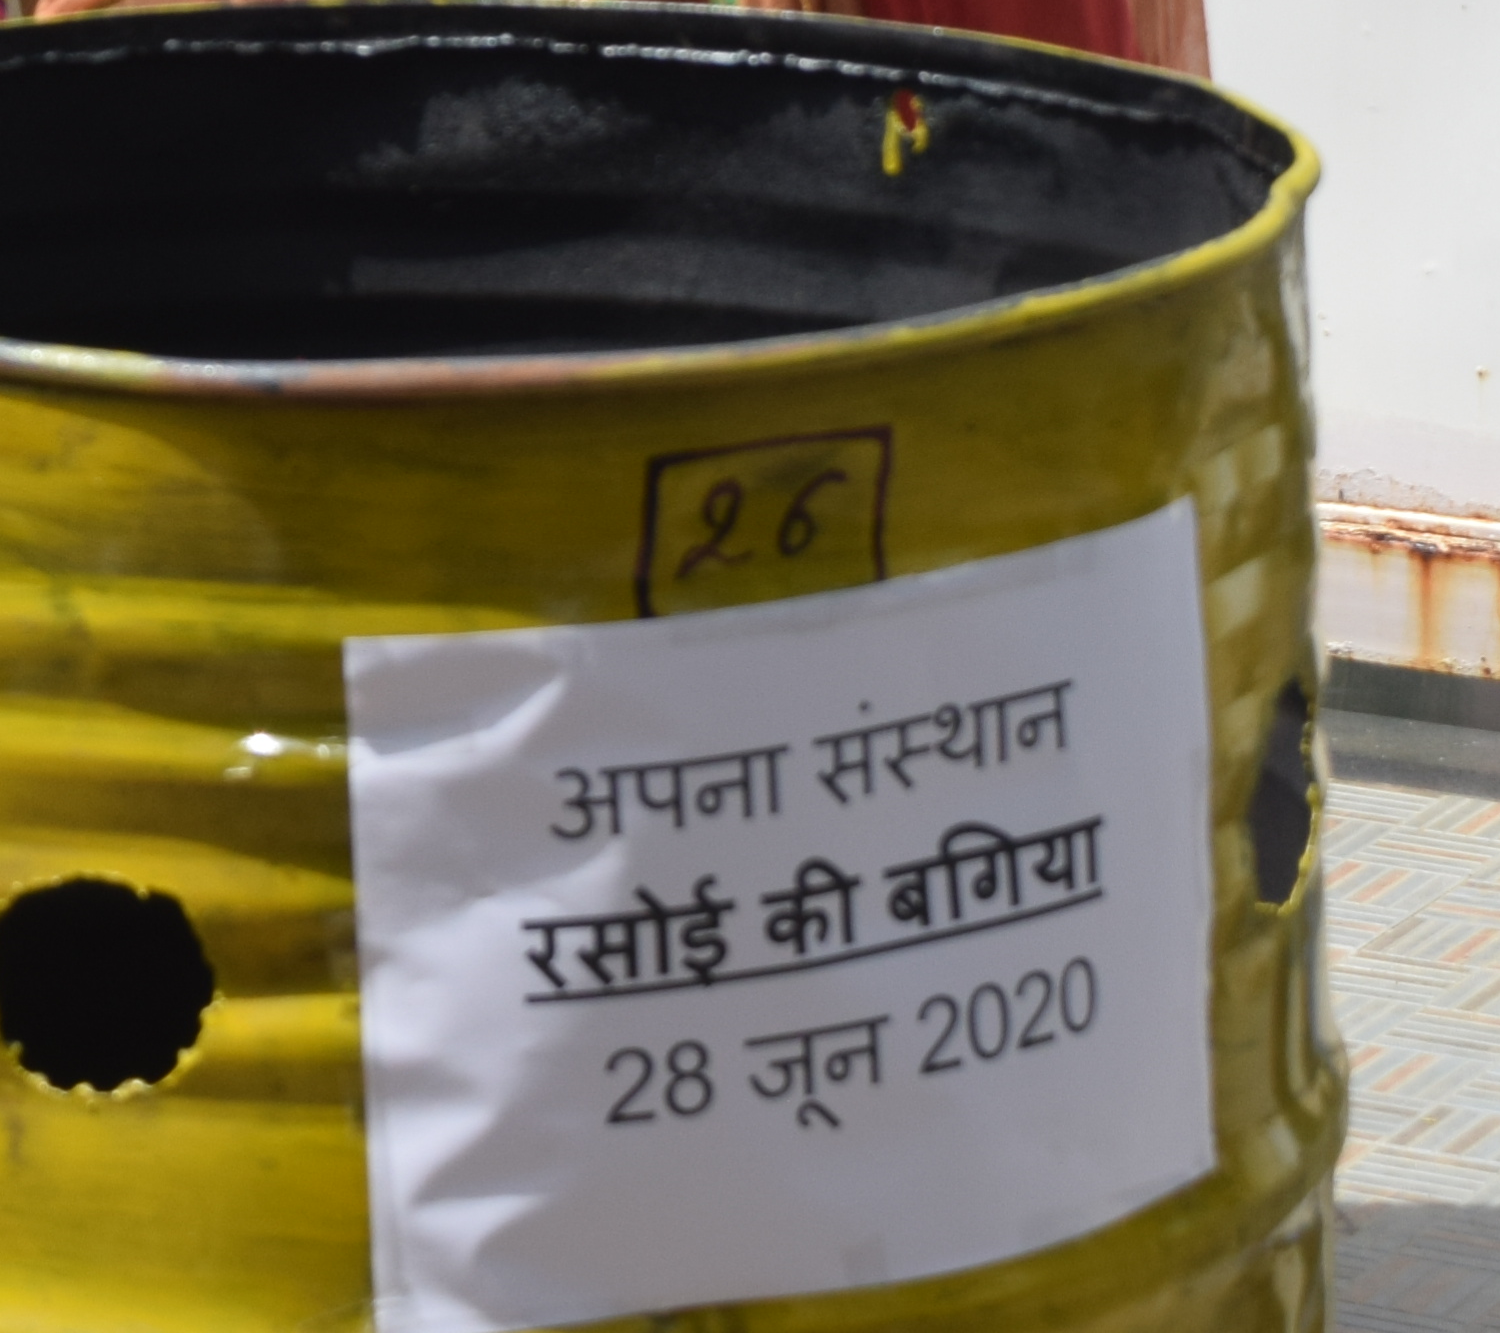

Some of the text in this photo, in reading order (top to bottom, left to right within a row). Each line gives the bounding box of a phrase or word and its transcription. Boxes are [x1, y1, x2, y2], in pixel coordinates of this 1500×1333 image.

[549, 679, 1073, 841] अपना संस्थान
[523, 816, 1104, 991] रसोई की बगिया
[605, 956, 1098, 1129] 28 जून 2020
